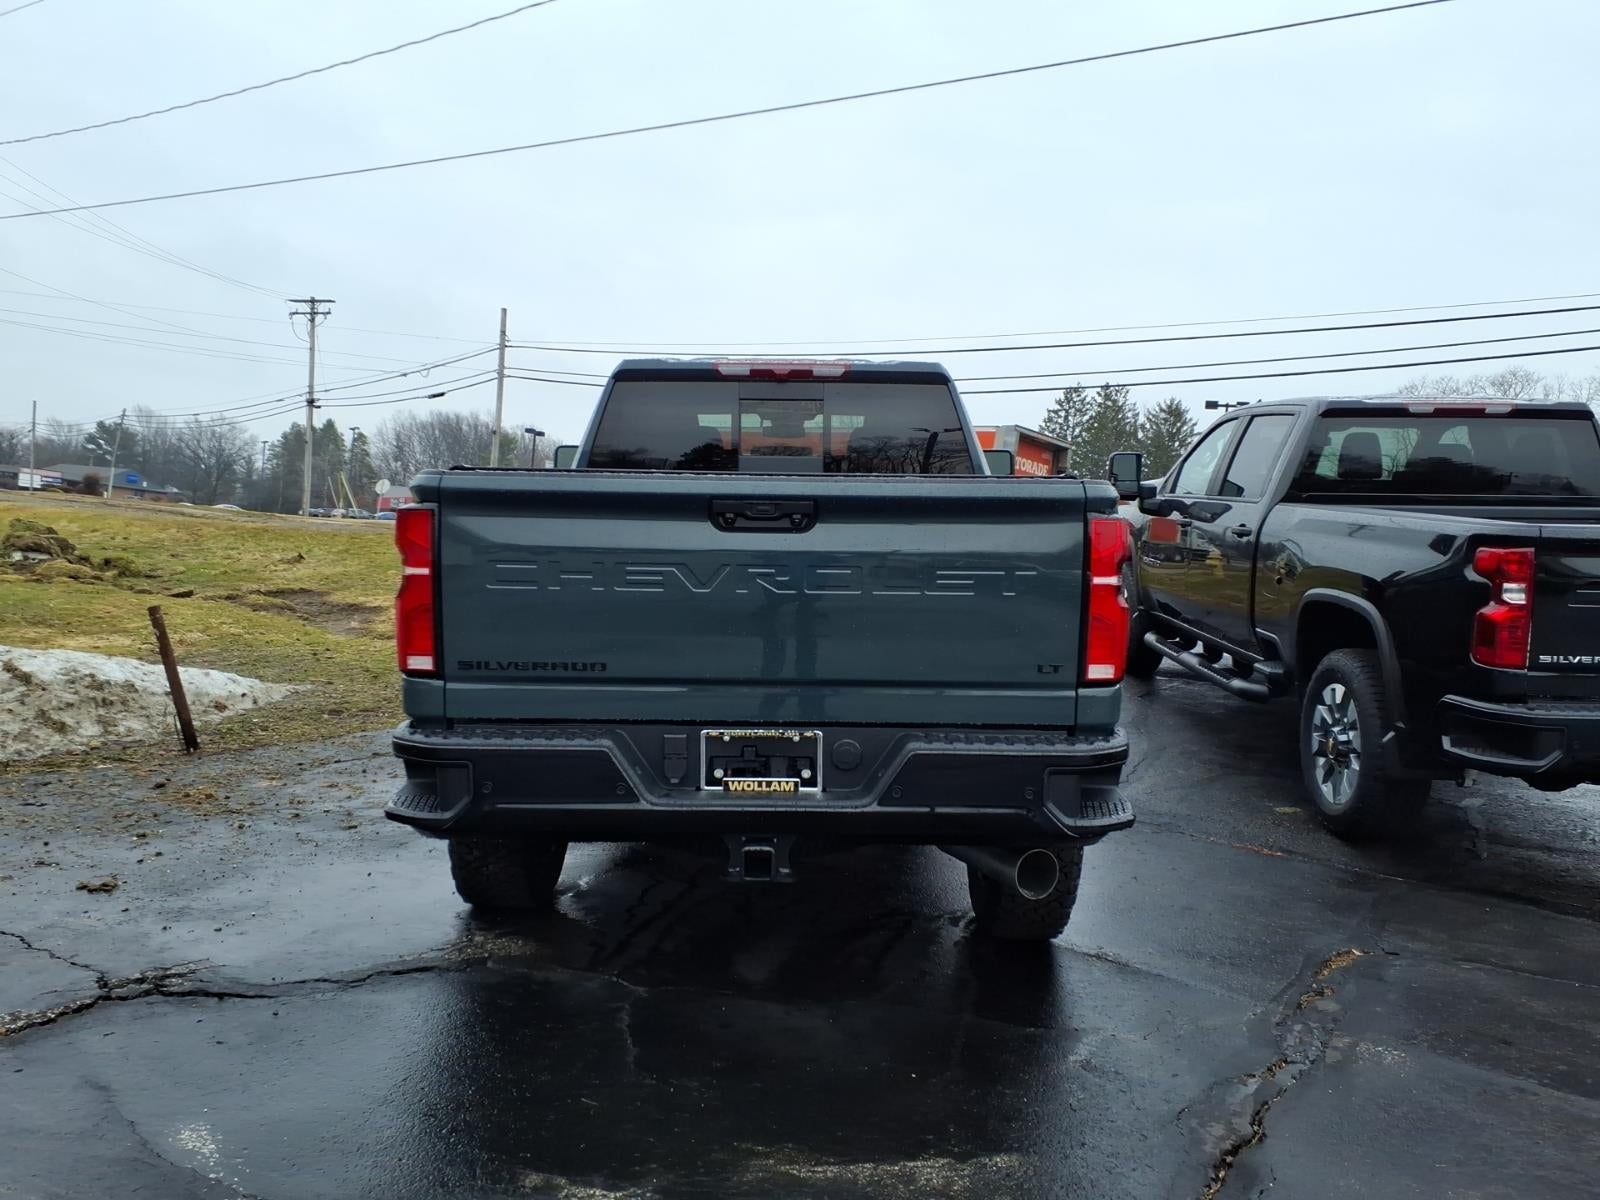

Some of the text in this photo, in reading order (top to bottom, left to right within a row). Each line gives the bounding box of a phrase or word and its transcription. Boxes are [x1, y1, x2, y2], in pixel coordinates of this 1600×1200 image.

[486, 559, 1037, 596] CHEVROLET
[457, 660, 607, 672] SILVERADO
[1037, 664, 1064, 674] LT
[729, 781, 794, 791] WOLLAM
